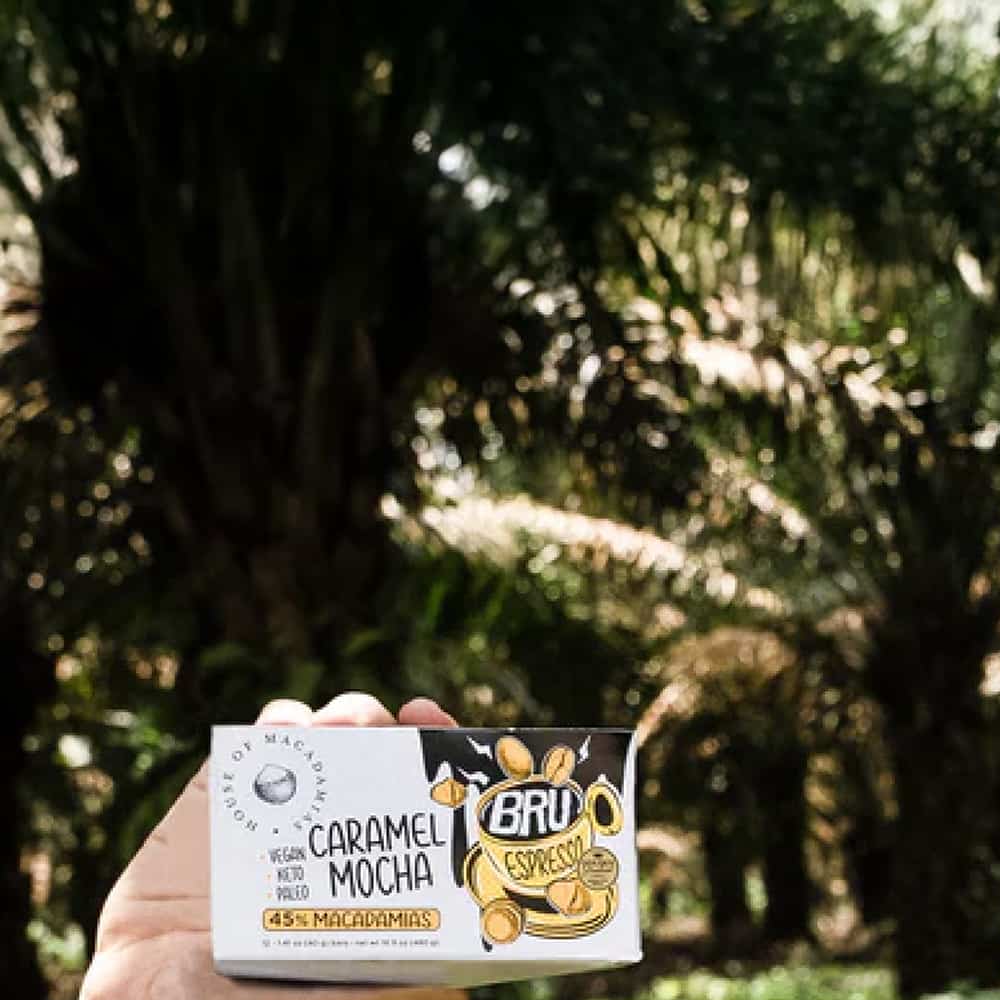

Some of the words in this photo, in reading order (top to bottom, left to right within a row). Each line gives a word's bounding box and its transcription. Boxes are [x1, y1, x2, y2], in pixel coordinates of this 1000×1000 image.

[488, 788, 572, 838] BRU
[308, 812, 447, 858] CARAMEL
[268, 847, 307, 864] VEGAN
[504, 835, 583, 881] ESPRESSO
[277, 866, 304, 883] KETO
[329, 851, 434, 899] MOCHA
[276, 884, 310, 901] PALEO
[269, 911, 309, 928] 45%
[313, 911, 433, 929] MACADAMIAS
